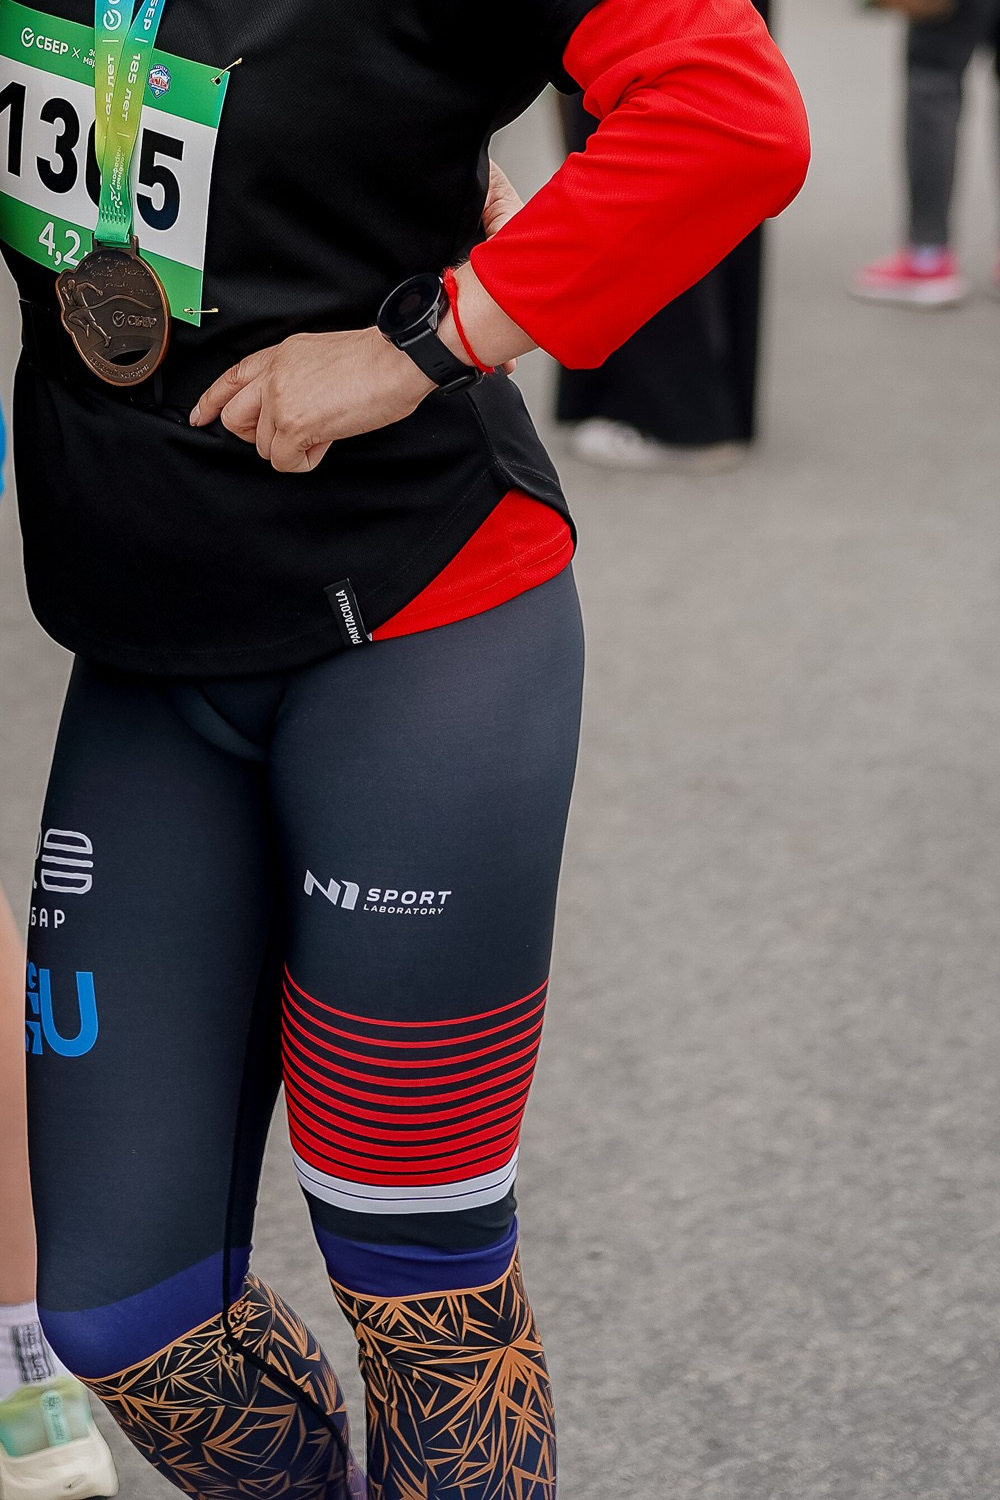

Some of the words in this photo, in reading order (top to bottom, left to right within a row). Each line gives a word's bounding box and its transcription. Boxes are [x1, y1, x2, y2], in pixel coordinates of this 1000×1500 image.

[36, 35, 69, 55] СБЕР
[127, 53, 141, 85] 185
[335, 589, 363, 645] PANTACOLLA
[366, 888, 452, 905] SPORT
[363, 903, 444, 915] LABORATORY
